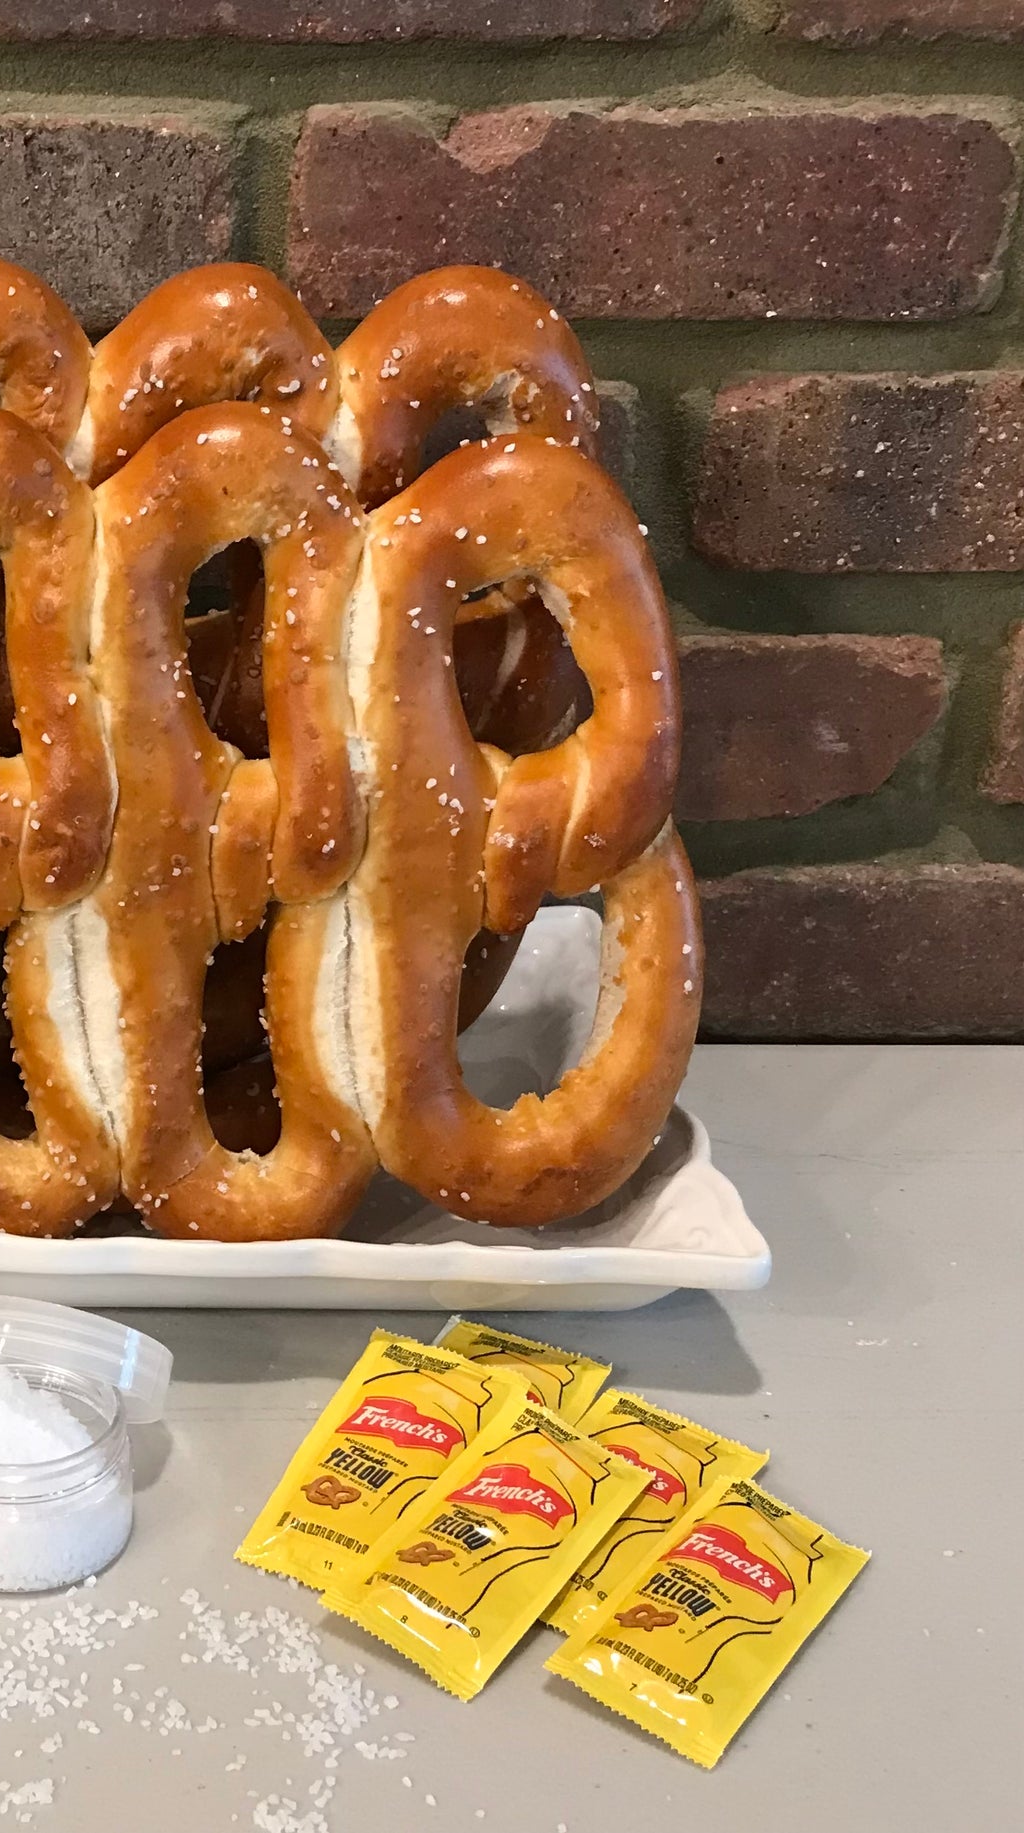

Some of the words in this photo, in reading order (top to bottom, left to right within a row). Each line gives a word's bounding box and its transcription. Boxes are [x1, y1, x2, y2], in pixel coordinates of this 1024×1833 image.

[351, 1405, 447, 1443] French's
[324, 1448, 394, 1489] YELLOW
[349, 1445, 387, 1467] Classic
[463, 1477, 557, 1513] French's
[426, 1513, 492, 1551] YELLOW
[324, 1560, 333, 1570] 11
[677, 1533, 775, 1588] French's
[642, 1572, 716, 1617] YELLOW
[669, 1568, 711, 1595] Classic
[400, 1615, 408, 1624] 8
[629, 1682, 637, 1691] 7
